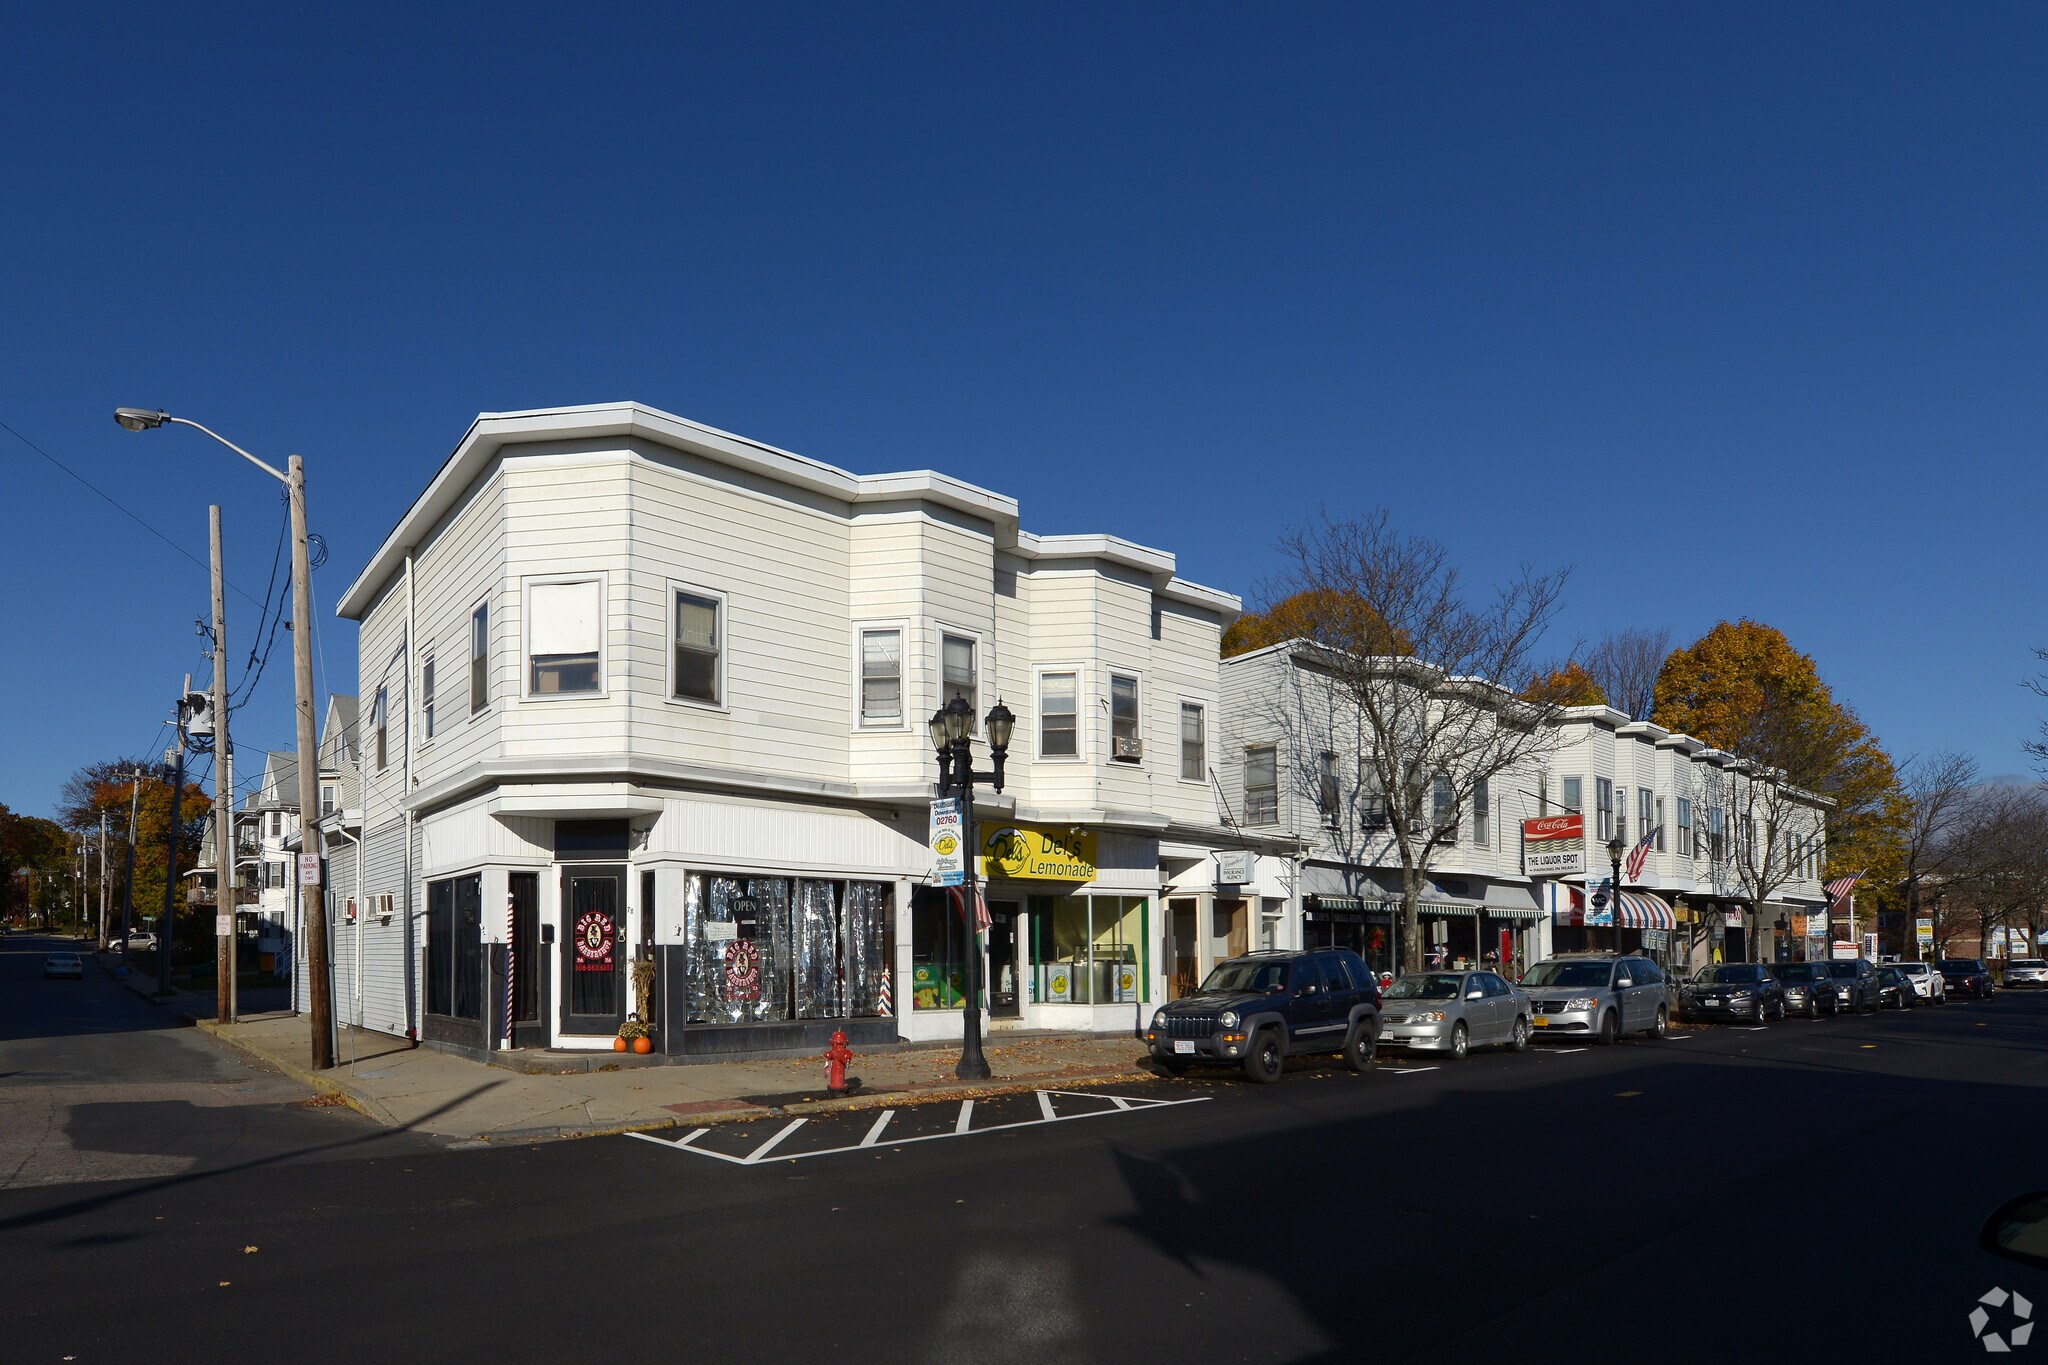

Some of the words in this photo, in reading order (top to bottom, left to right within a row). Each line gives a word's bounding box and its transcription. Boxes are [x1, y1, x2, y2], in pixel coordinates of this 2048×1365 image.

[936, 815, 958, 825] 02760
[1537, 818, 1569, 831] Coca-Cola
[994, 838, 1023, 861] Del's
[1041, 833, 1082, 857] Del's
[1029, 858, 1094, 878] Lemonade
[1528, 856, 1539, 866] THE
[1540, 855, 1562, 865] LIQUOR
[1562, 854, 1578, 864] SPOT
[733, 900, 757, 911] OPEN
[577, 914, 592, 932] BIG
[593, 913, 612, 932] RED
[577, 940, 612, 959] BARBERSHOP
[726, 942, 740, 960] BIG
[742, 941, 758, 960] RED
[726, 967, 758, 987] BARBERSHOP
